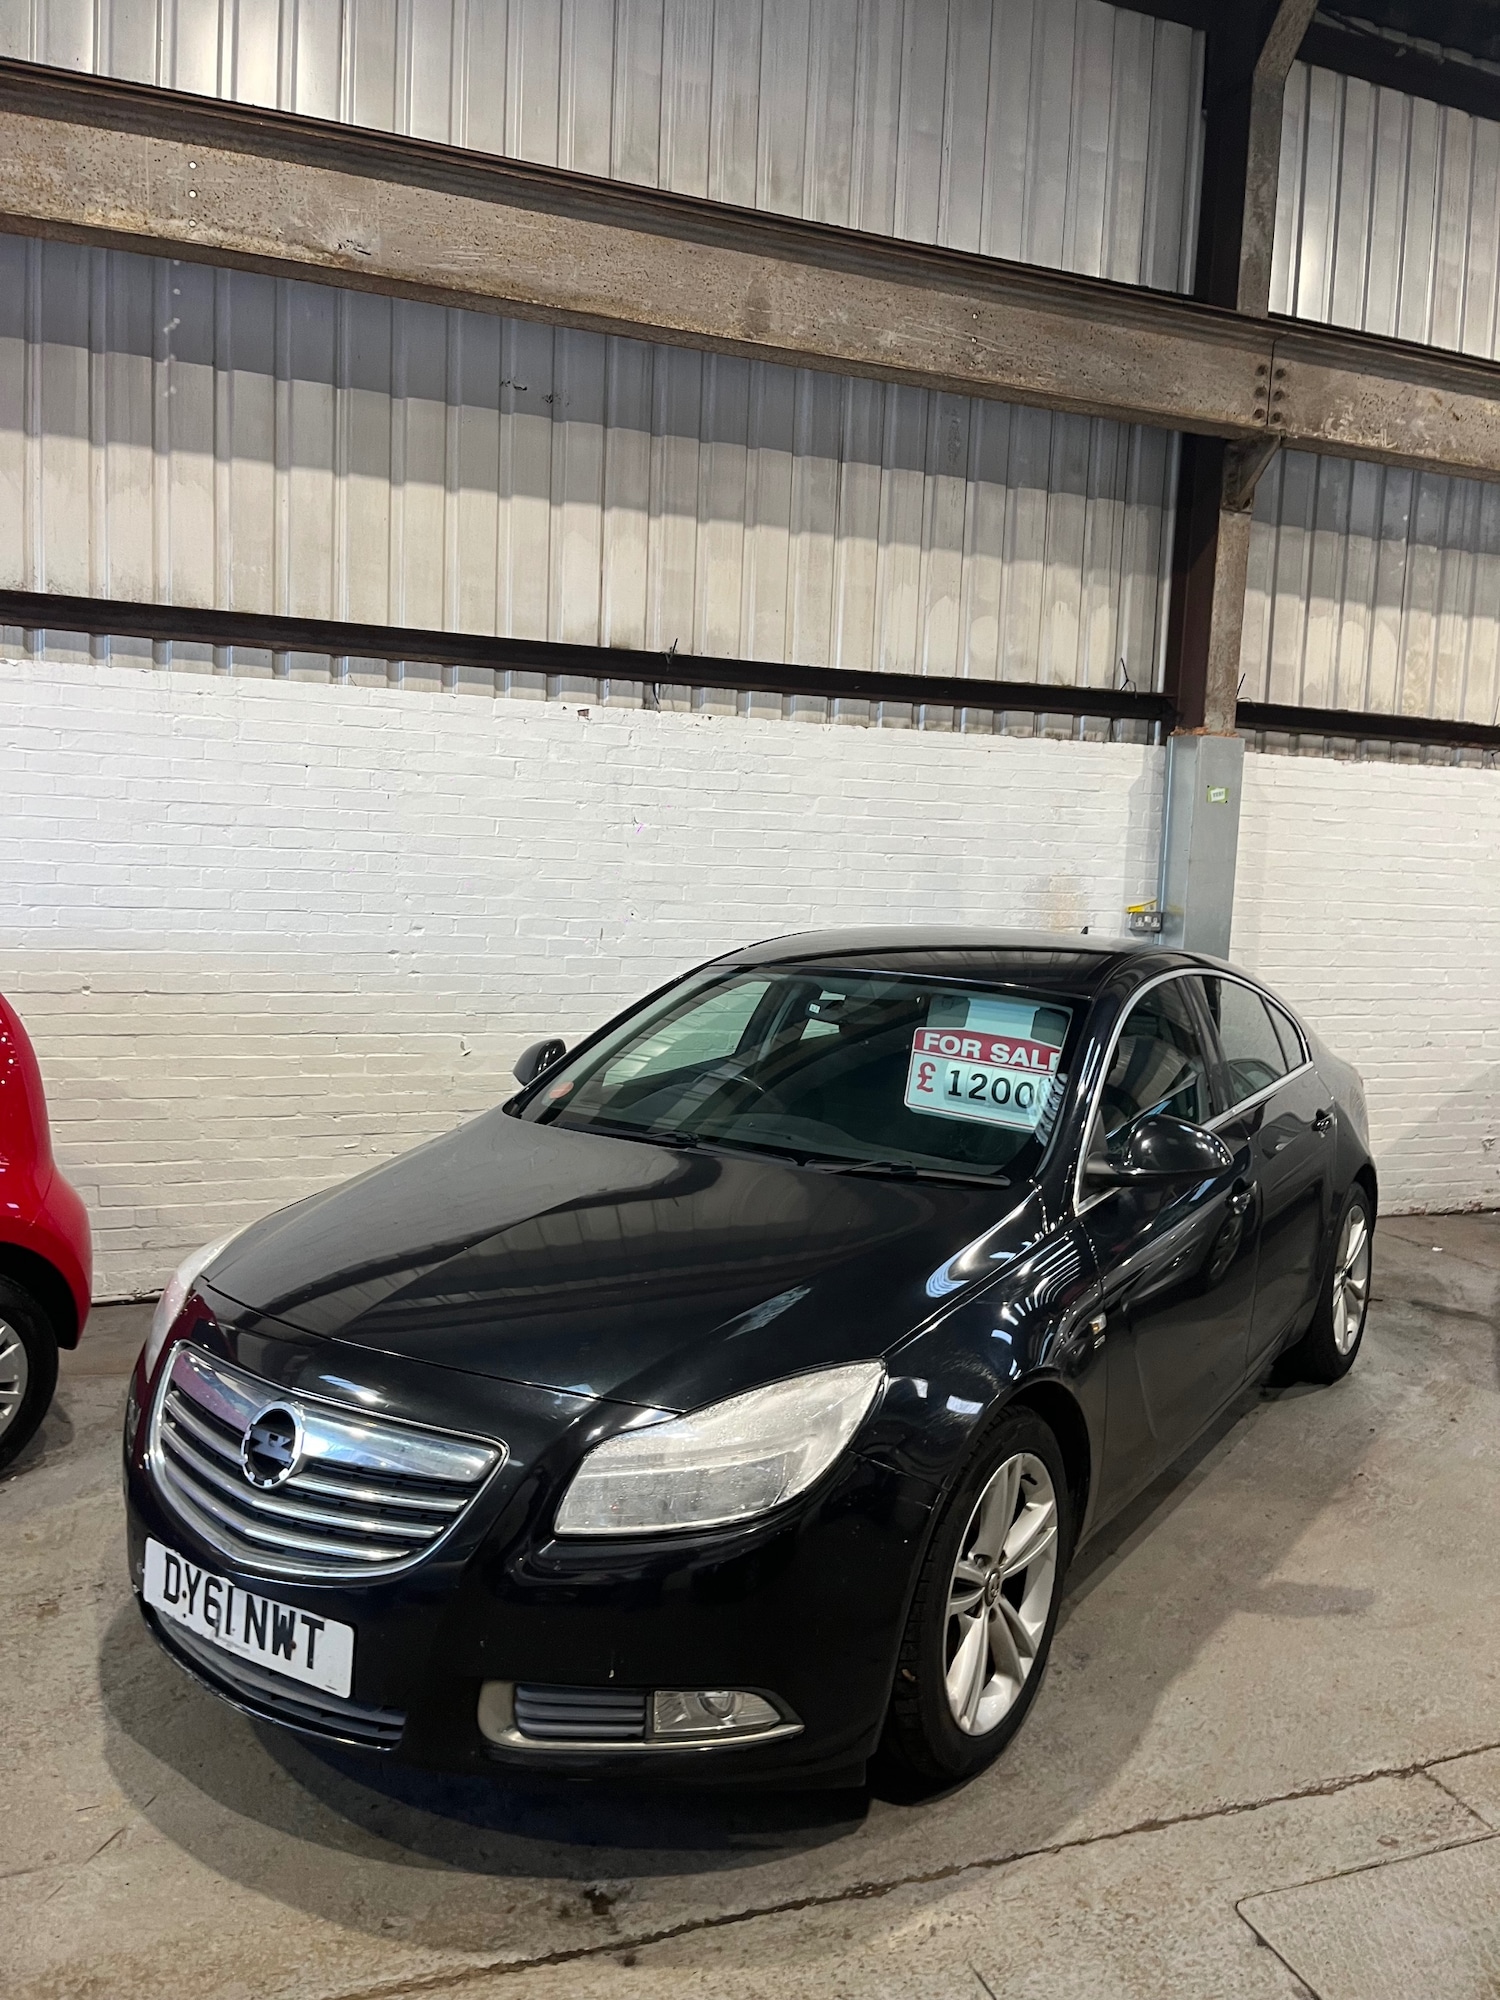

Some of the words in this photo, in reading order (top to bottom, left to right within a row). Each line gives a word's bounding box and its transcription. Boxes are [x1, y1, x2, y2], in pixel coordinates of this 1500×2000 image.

[922, 1032, 982, 1059] FOR
[916, 1061, 937, 1093] £
[947, 1069, 1035, 1109] 1200
